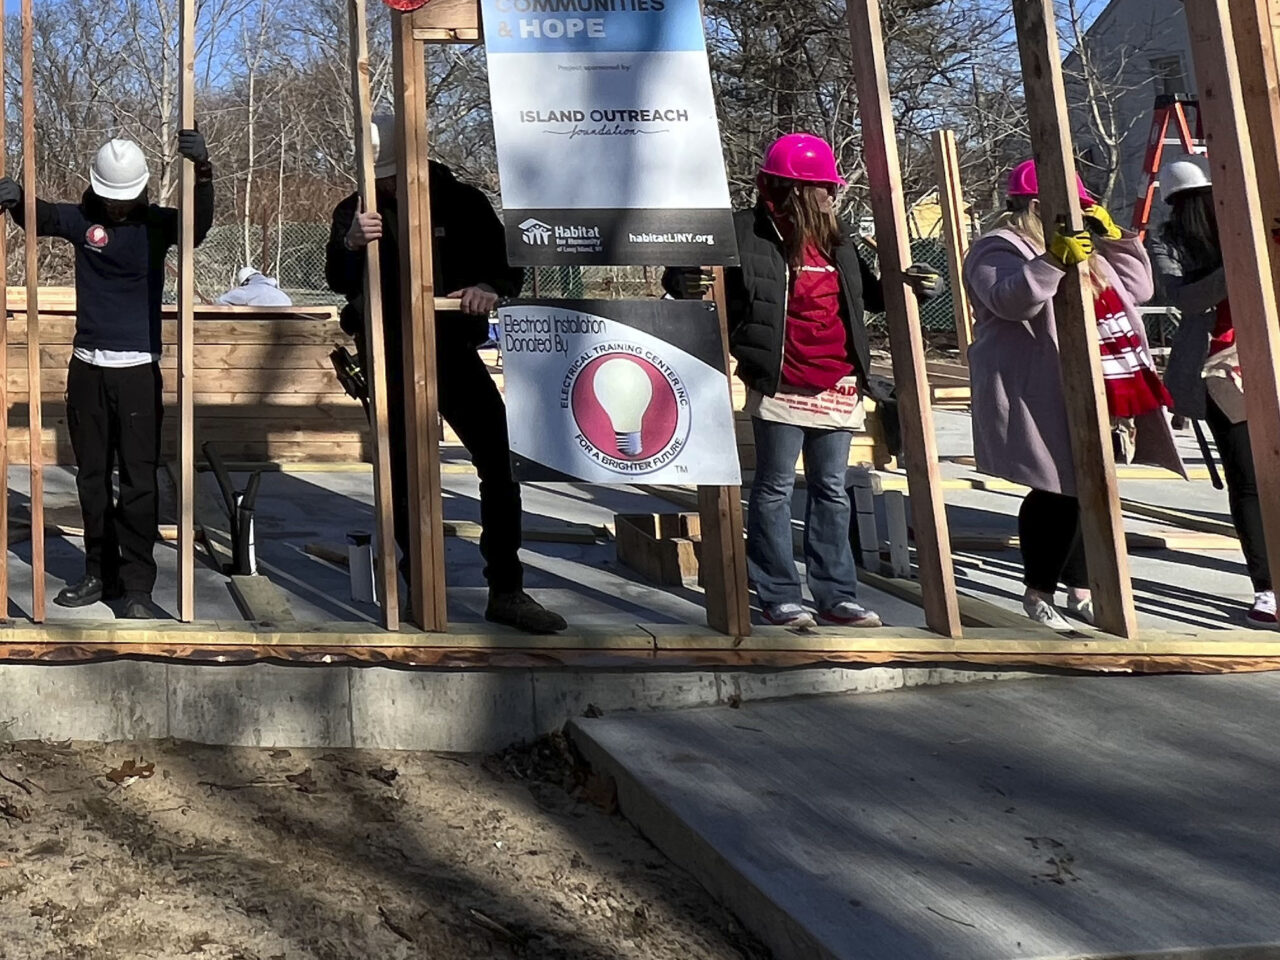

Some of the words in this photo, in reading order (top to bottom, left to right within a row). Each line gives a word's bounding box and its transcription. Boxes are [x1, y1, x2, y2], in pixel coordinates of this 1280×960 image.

[498, 21, 512, 38] &
[520, 18, 607, 39] HOPE
[520, 110, 585, 123] ISLAND
[590, 109, 689, 122] OUTREACH
[569, 124, 642, 139] foundation
[554, 225, 600, 238] Habitat
[629, 233, 714, 245] habitatLINY.org
[504, 315, 551, 334] Electrical
[553, 314, 607, 334] Installation
[506, 334, 552, 352] Donated
[555, 334, 569, 356] By
[560, 351, 593, 409] ELECTRICAL
[592, 343, 643, 355] TRAINING
[645, 351, 680, 387] CENTER
[575, 433, 593, 454] FOR
[592, 451, 600, 460] A
[601, 457, 652, 471] BRIGHTER
[674, 465, 688, 473] TM
